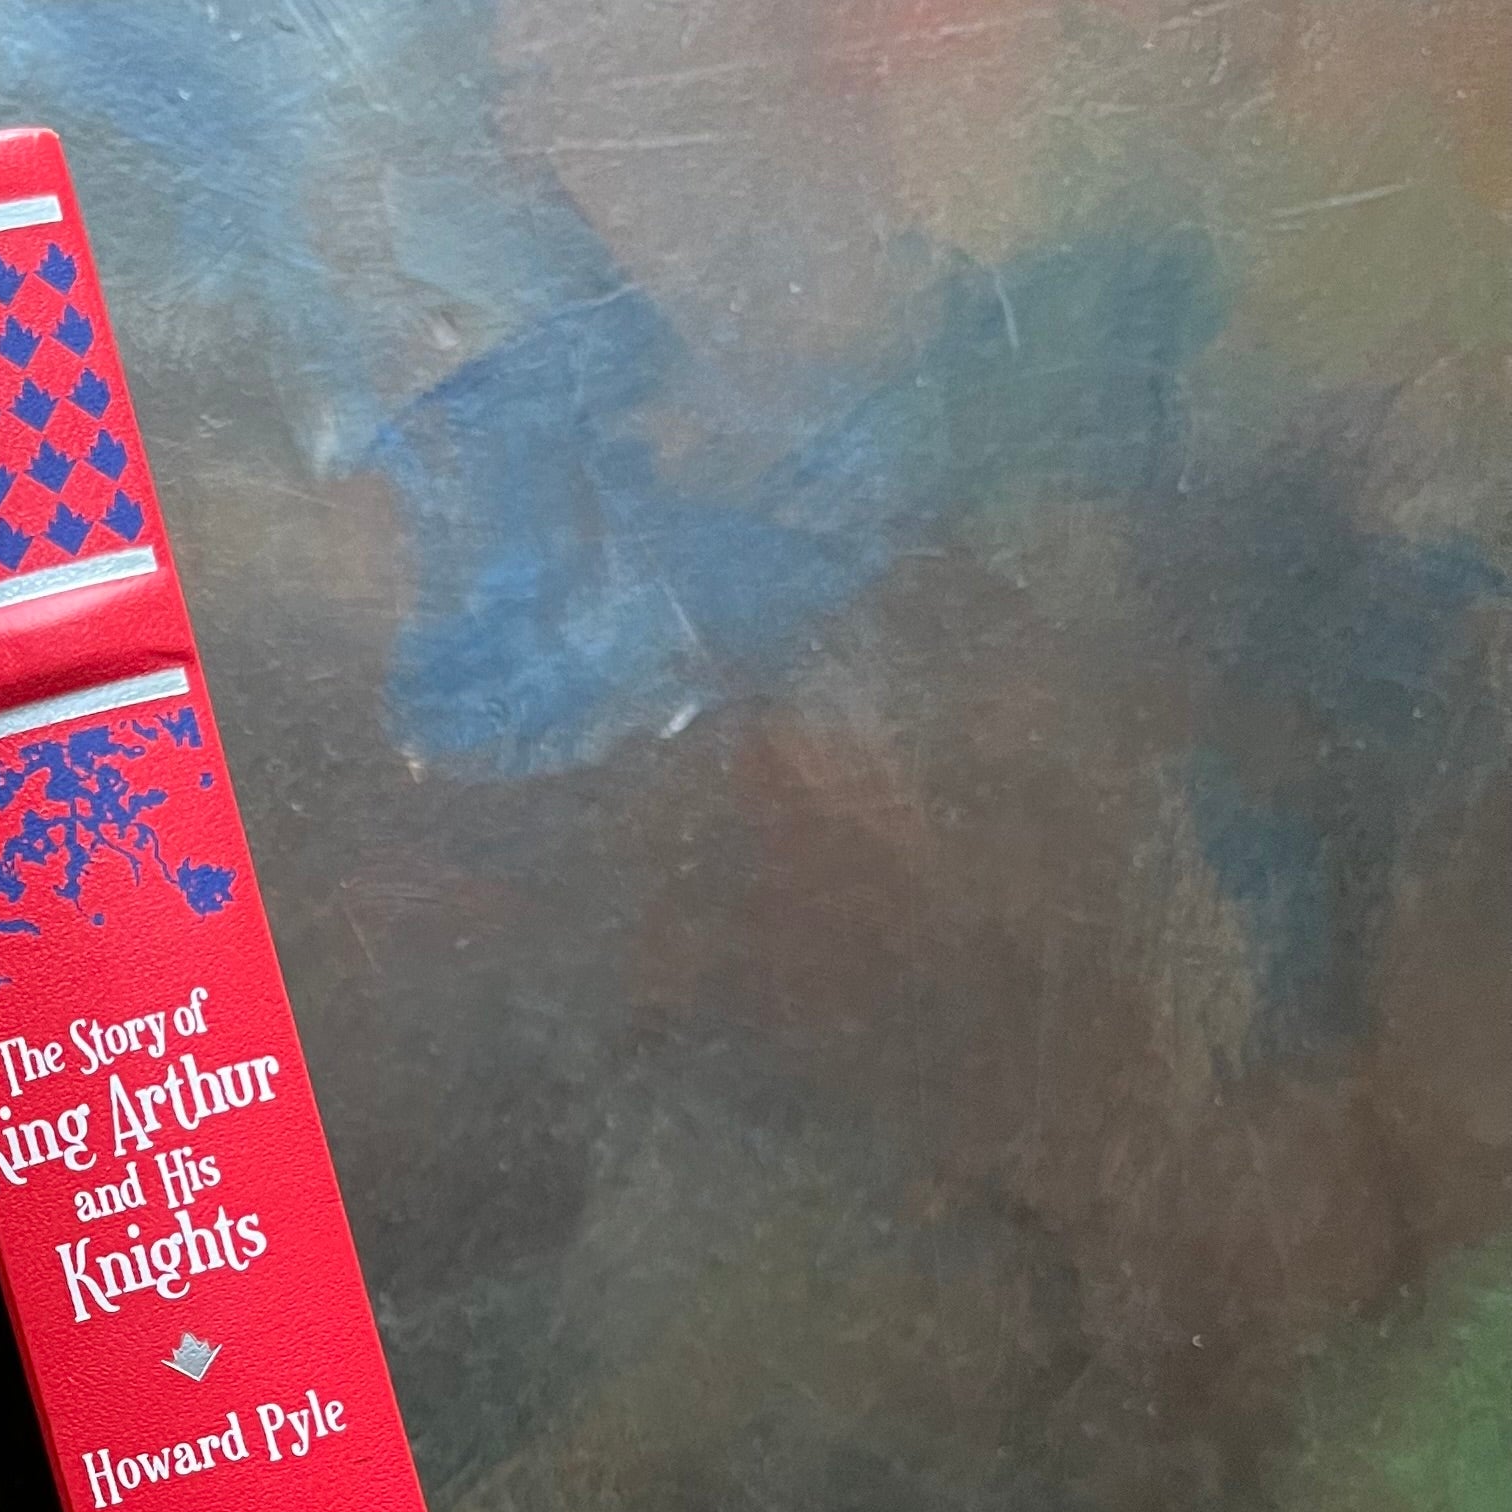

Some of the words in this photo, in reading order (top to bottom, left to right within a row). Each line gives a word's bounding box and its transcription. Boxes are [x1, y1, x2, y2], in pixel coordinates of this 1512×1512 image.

[69, 1011, 166, 1075] Story
[172, 986, 209, 1037] of
[109, 1053, 280, 1158] Arthur
[74, 1161, 148, 1223] and
[153, 1146, 222, 1210] His
[54, 1205, 268, 1323] Knights
[81, 1411, 250, 1509] Howard
[255, 1389, 347, 1462] Pyle
